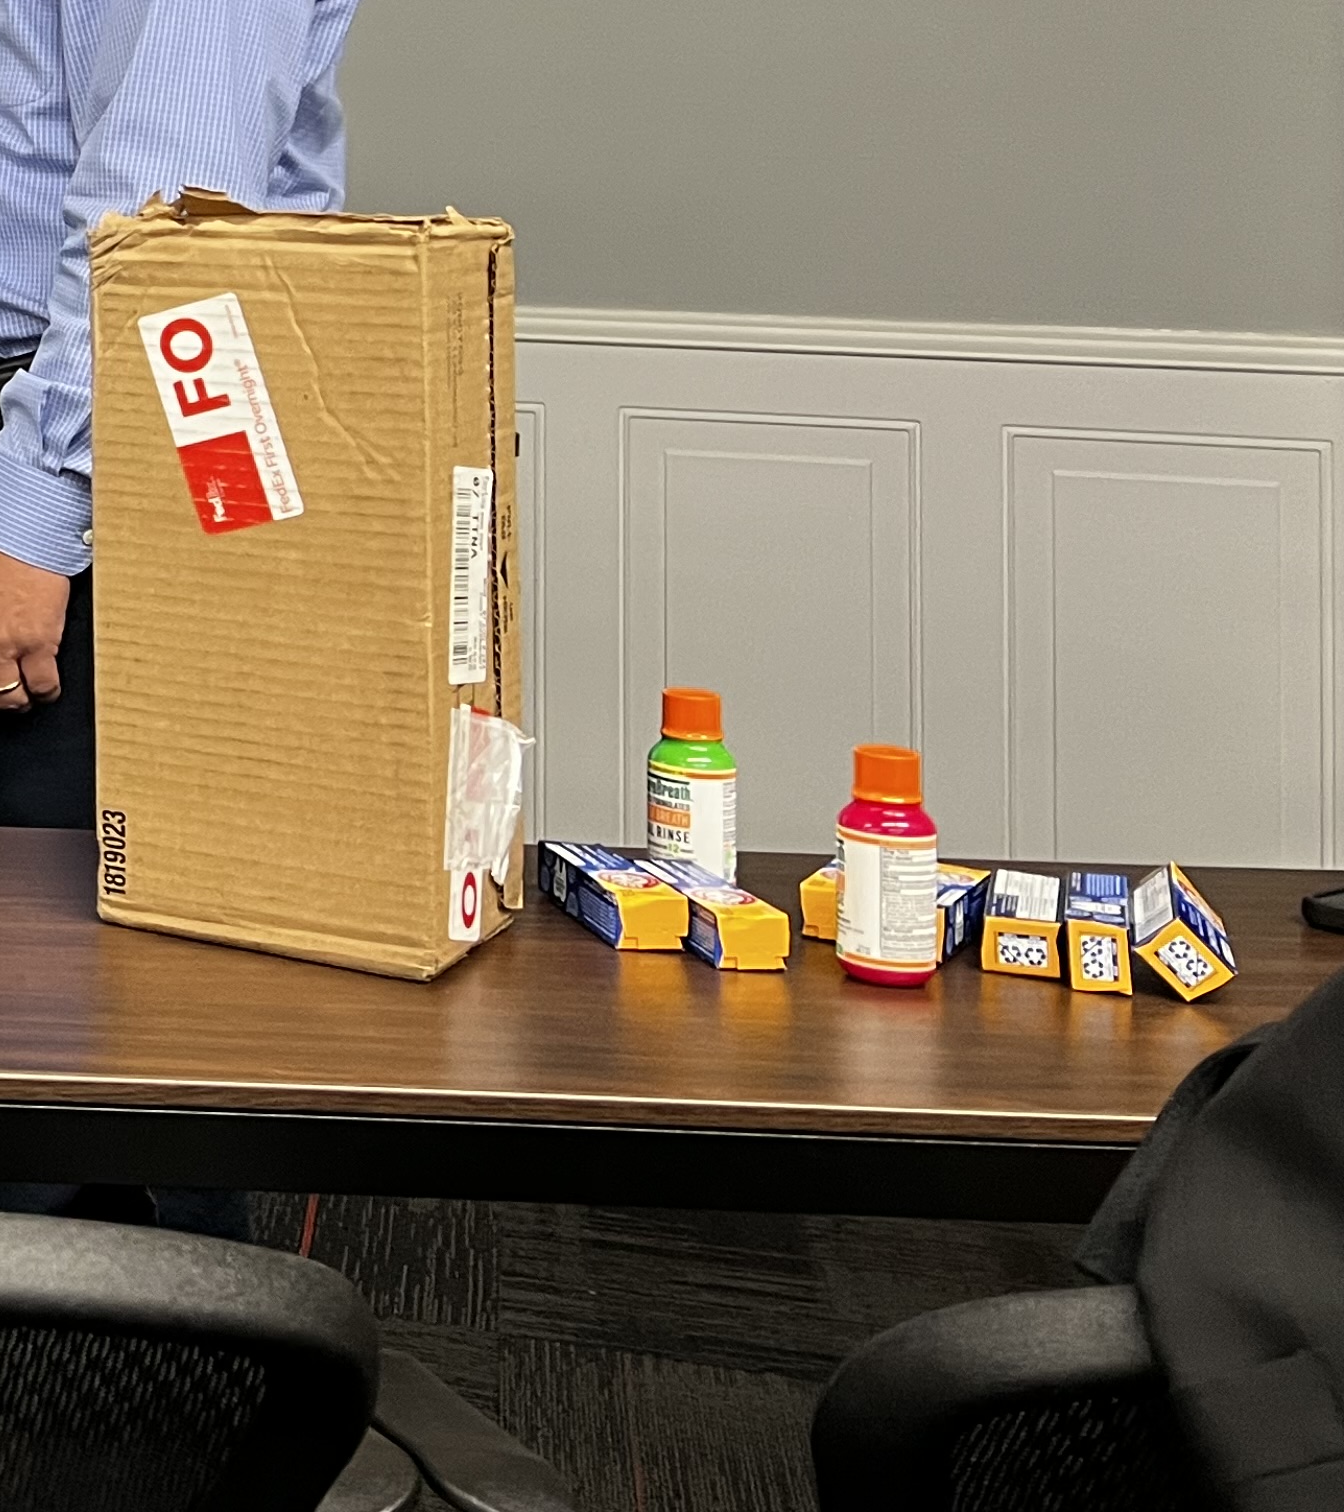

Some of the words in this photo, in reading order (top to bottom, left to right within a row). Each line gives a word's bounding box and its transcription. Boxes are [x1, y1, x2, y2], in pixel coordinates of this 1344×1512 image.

[160, 317, 231, 417] FO
[260, 436, 278, 468] First
[270, 469, 293, 514] FedEx
[102, 810, 126, 895] 1819023
[656, 825, 690, 844] RINSE
